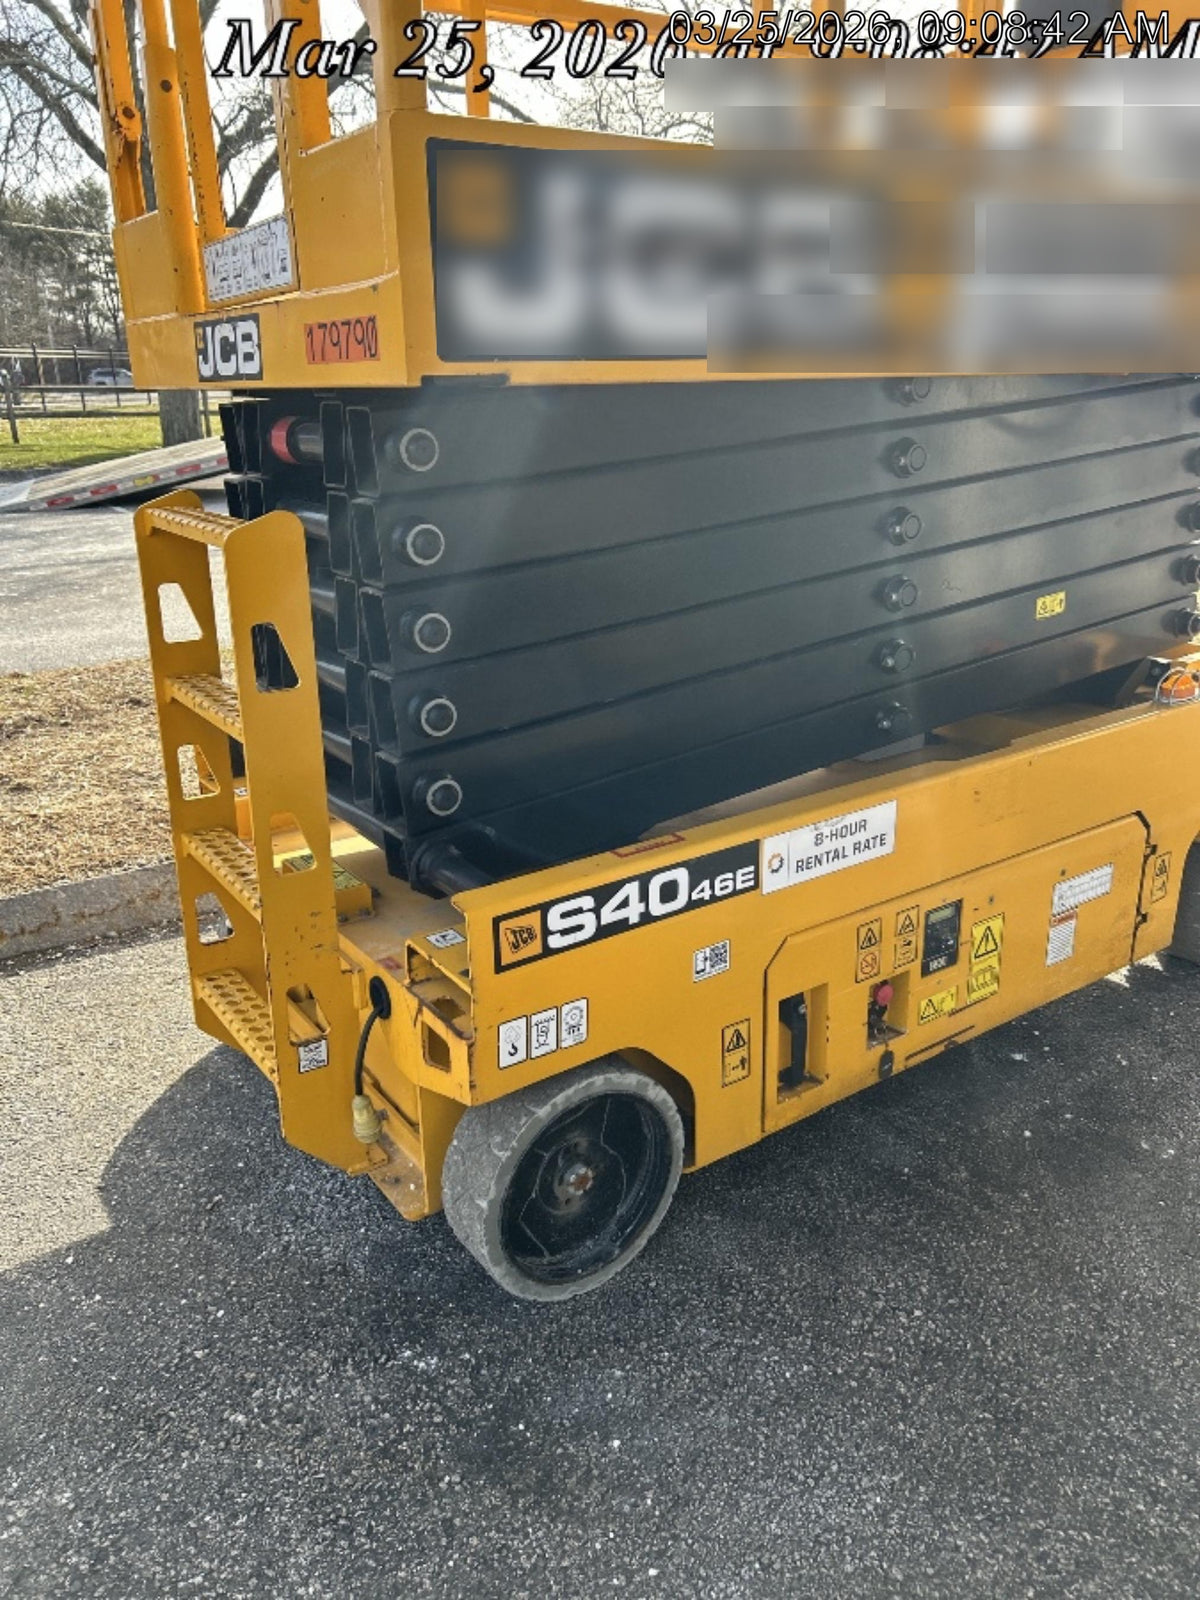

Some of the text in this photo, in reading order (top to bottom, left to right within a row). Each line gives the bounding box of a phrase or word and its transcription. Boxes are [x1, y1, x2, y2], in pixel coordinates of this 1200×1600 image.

[198, 319, 261, 378] JCB
[306, 315, 378, 362] 179790
[795, 833, 887, 873] RENTAL RATE
[814, 819, 867, 847] 8-HOUR
[510, 927, 535, 951] JCB
